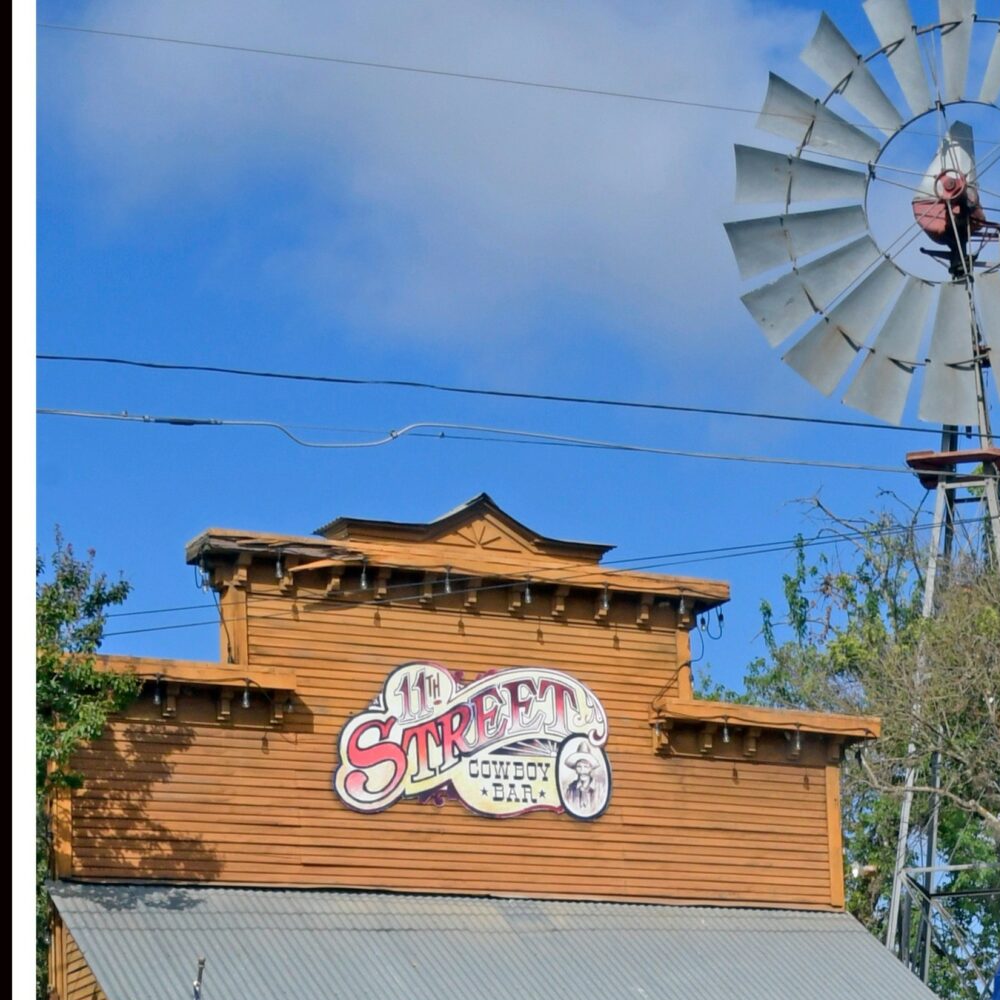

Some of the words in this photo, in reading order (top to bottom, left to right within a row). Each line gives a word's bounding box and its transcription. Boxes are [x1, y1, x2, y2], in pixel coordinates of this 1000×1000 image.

[393, 667, 441, 724] 11TH
[343, 677, 580, 804] STREET
[468, 758, 551, 782] COWBOY
[492, 783, 538, 804] BAR
